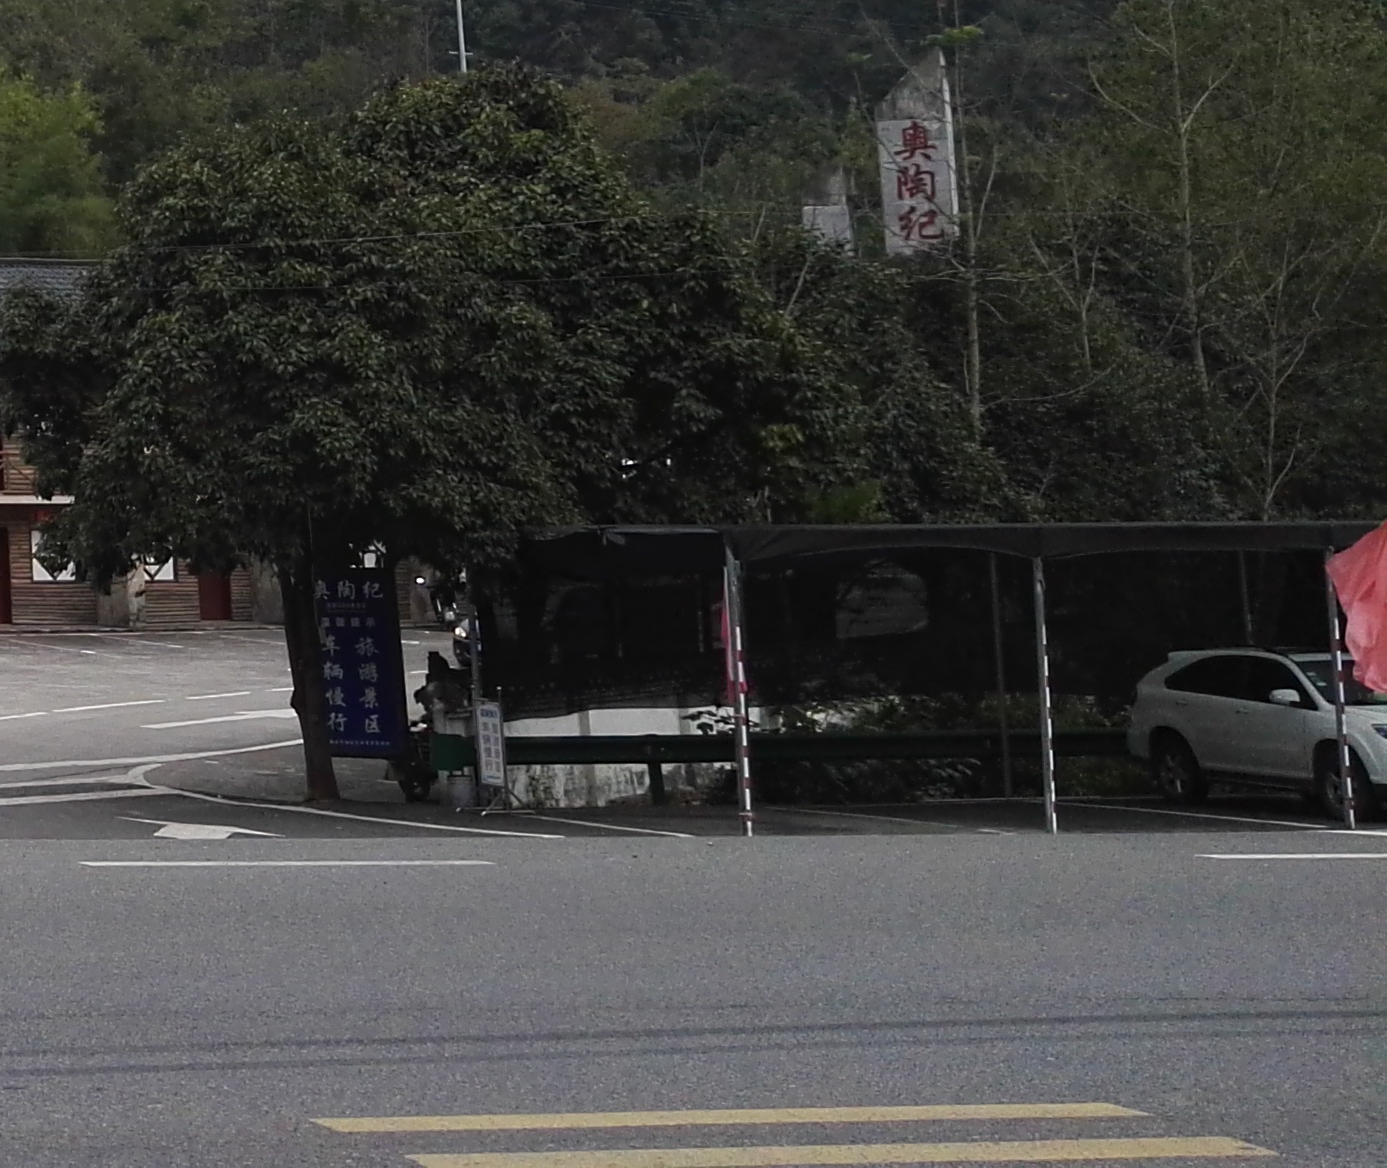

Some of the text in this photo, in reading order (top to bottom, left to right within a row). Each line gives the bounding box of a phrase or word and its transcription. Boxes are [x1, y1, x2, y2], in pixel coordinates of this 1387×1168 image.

[894, 121, 945, 241] 奥陶纪
[313, 579, 384, 600] 奥陶纪
[355, 636, 381, 734] 旅游景区
